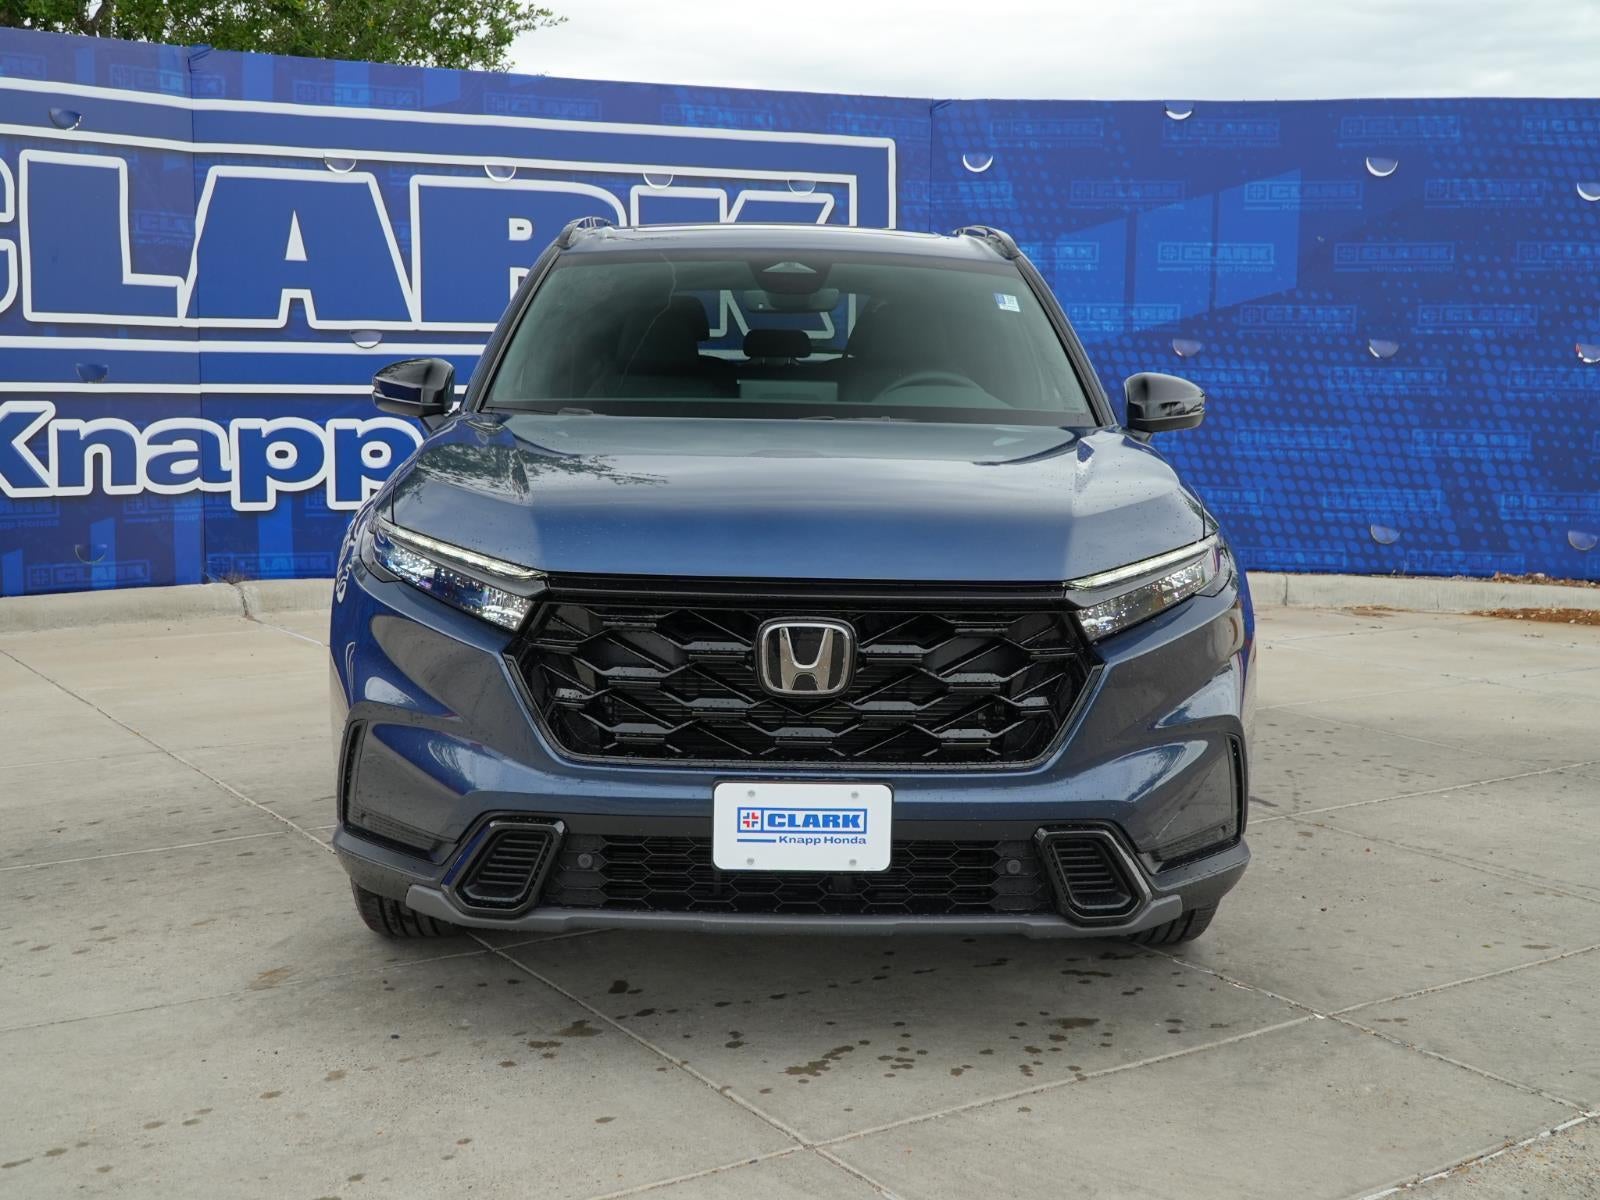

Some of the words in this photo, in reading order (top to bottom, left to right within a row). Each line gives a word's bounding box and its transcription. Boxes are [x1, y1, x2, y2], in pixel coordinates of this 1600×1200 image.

[1271, 185, 1357, 198] CLARK
[1183, 246, 1271, 260] CLARK
[1360, 246, 1449, 259] CLARK
[0, 400, 425, 512] Knapp
[238, 556, 330, 574] CLARK
[57, 563, 145, 585] CLARK
[767, 813, 861, 828] CLARK
[779, 836, 822, 846] Knapp
[823, 836, 867, 845] Honda
